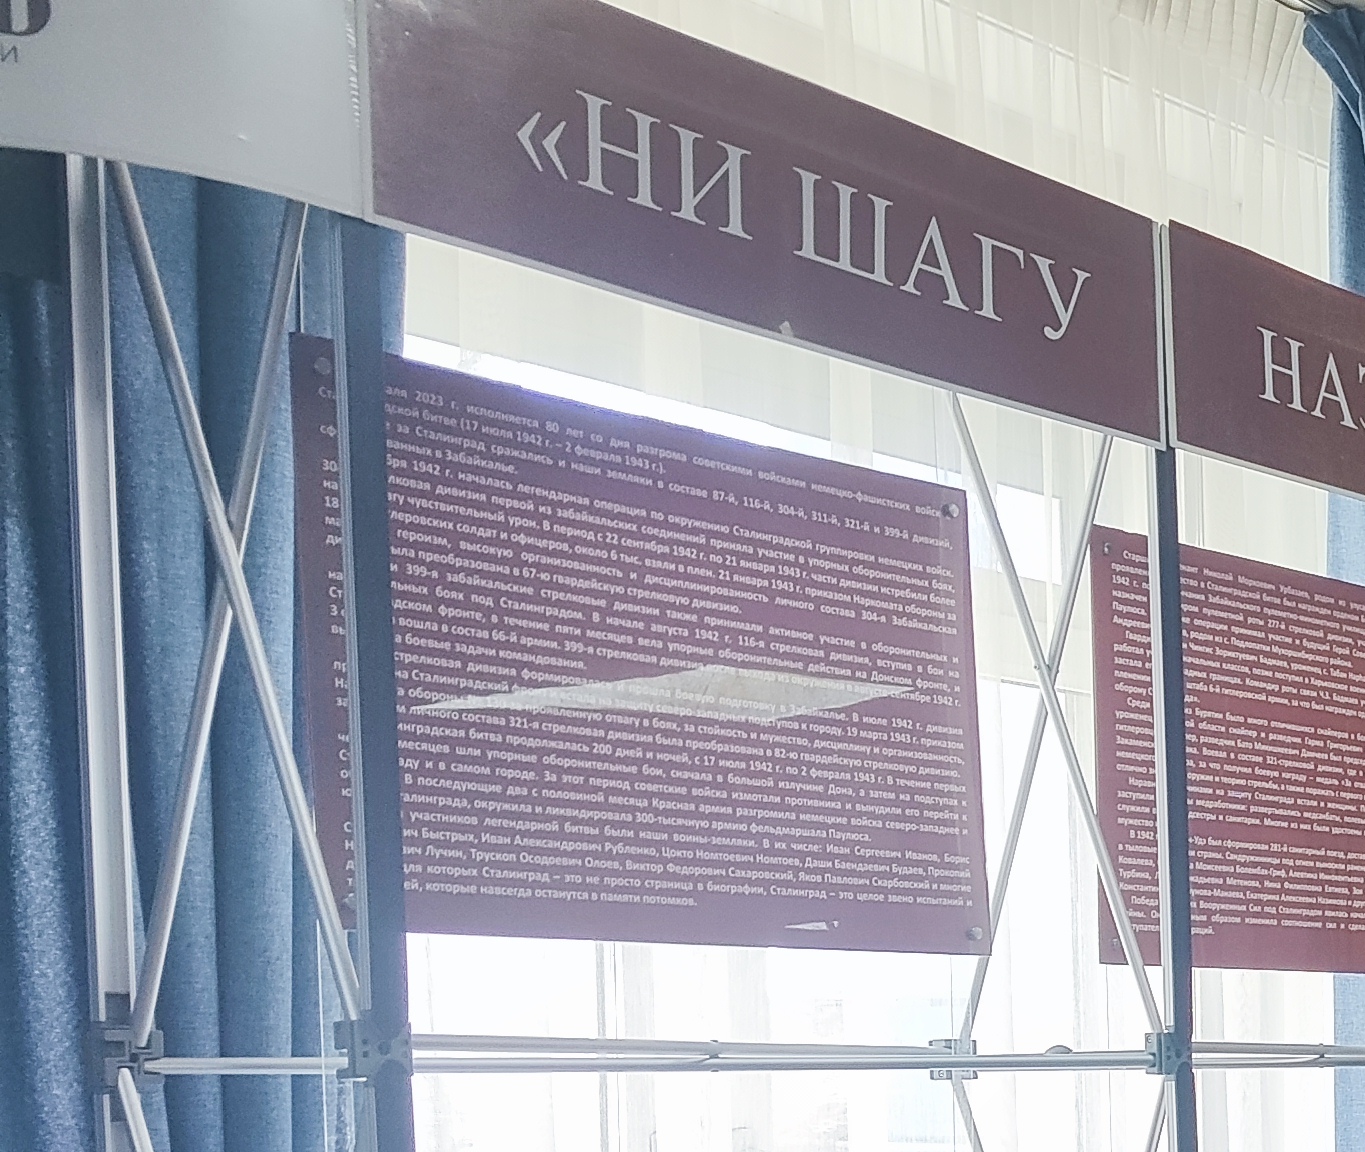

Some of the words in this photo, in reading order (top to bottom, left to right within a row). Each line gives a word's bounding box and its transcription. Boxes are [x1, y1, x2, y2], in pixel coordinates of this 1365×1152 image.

[517, 90, 753, 242] «НИ
[793, 166, 1091, 340] ШАГУ
[414, 389, 445, 407] 2023
[450, 400, 460, 411] г.
[465, 404, 540, 429] исполняется
[544, 419, 561, 434] 80
[564, 426, 585, 439] лет
[589, 432, 604, 444] со
[608, 436, 631, 450] дня
[691, 455, 754, 478] советскими
[757, 469, 807, 489] войсками
[412, 459, 441, 477] 1942
[444, 468, 454, 479] г.
[457, 470, 514, 491] началась
[516, 482, 591, 507] легендарная
[592, 498, 648, 518] операция
[649, 510, 665, 522] по
[666, 513, 731, 535] окружению
[732, 524, 813, 551] Сталинградской
[877, 555, 924, 573] немецких
[925, 564, 955, 579] войск.
[395, 528, 452, 550] героизм,
[458, 539, 514, 559] высокую
[519, 550, 624, 579] организованность
[628, 570, 638, 581] и
[643, 573, 770, 604] дисциплинированность
[773, 595, 816, 612] личного
[819, 604, 856, 619] состава
[860, 608, 887, 624] 304-я
[468, 726, 504, 743] битва
[505, 734, 591, 753] продолжалась
[591, 741, 613, 756] 200
[614, 746, 644, 759] дней
[645, 750, 654, 760] и
[655, 751, 693, 766] ночей,
[693, 755, 701, 766] с
[702, 754, 716, 767] 17
[717, 758, 747, 770] июля
[748, 759, 774, 773] 1942
[774, 764, 784, 774] г.
[784, 765, 799, 776] по
[800, 765, 808, 777] 2
[808, 766, 852, 781] февраля
[852, 770, 876, 784] 1943
[876, 775, 885, 785] г.
[886, 774, 895, 786] В
[894, 777, 932, 790] течение
[408, 810, 479, 826] участников
[482, 816, 560, 833] легендарной
[563, 820, 600, 836] битвы
[603, 824, 635, 839] были
[638, 829, 669, 842] наши
[761, 837, 771, 849] В
[773, 840, 788, 850] их
[789, 842, 823, 853] числе:
[825, 842, 851, 855] Иван
[853, 844, 902, 859] Сергеевич
[904, 848, 942, 864] Иванов,
[943, 851, 971, 866] Борис
[424, 881, 478, 896] которые
[479, 884, 533, 899] навсегда
[533, 888, 590, 902] останутся
[590, 891, 599, 902] в
[599, 891, 641, 904] памяти
[641, 894, 698, 907] потомков.
